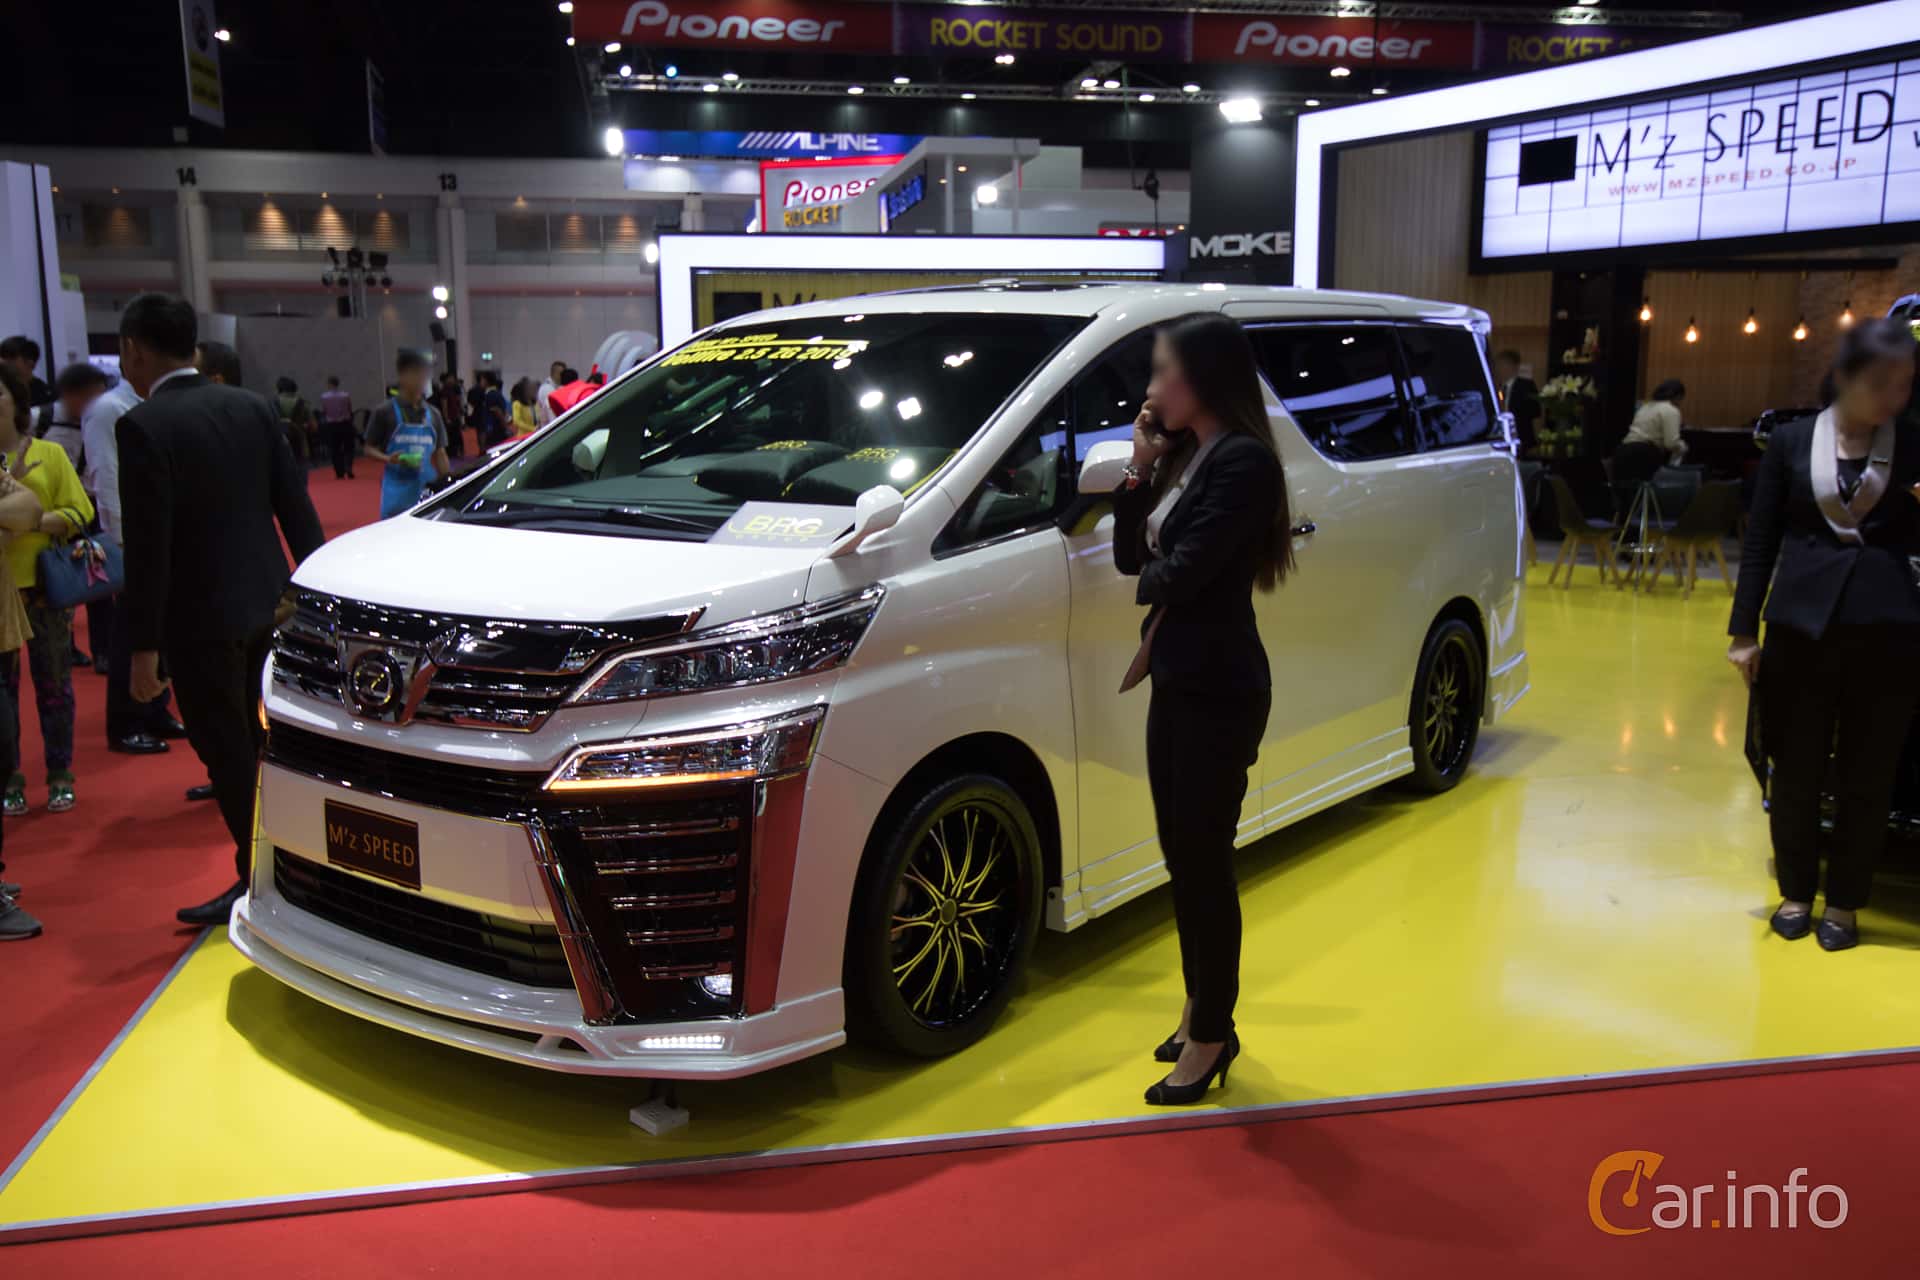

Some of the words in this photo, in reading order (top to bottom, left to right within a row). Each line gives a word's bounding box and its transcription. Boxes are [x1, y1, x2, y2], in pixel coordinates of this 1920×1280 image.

[620, 0, 845, 42] Pioneer
[930, 18, 1048, 48] ROCKET
[1233, 20, 1432, 59] Pioneer
[1507, 34, 1613, 62] ROCKET
[1704, 88, 1894, 164] SPEED
[783, 131, 882, 151] ALPINE
[176, 166, 197, 186] 14
[438, 173, 457, 192] 13
[783, 176, 880, 208] Pione
[783, 204, 842, 228] ROCKET
[1189, 231, 1292, 259] MOKE
[328, 823, 358, 849] M'z
[363, 832, 416, 868] SPEED
